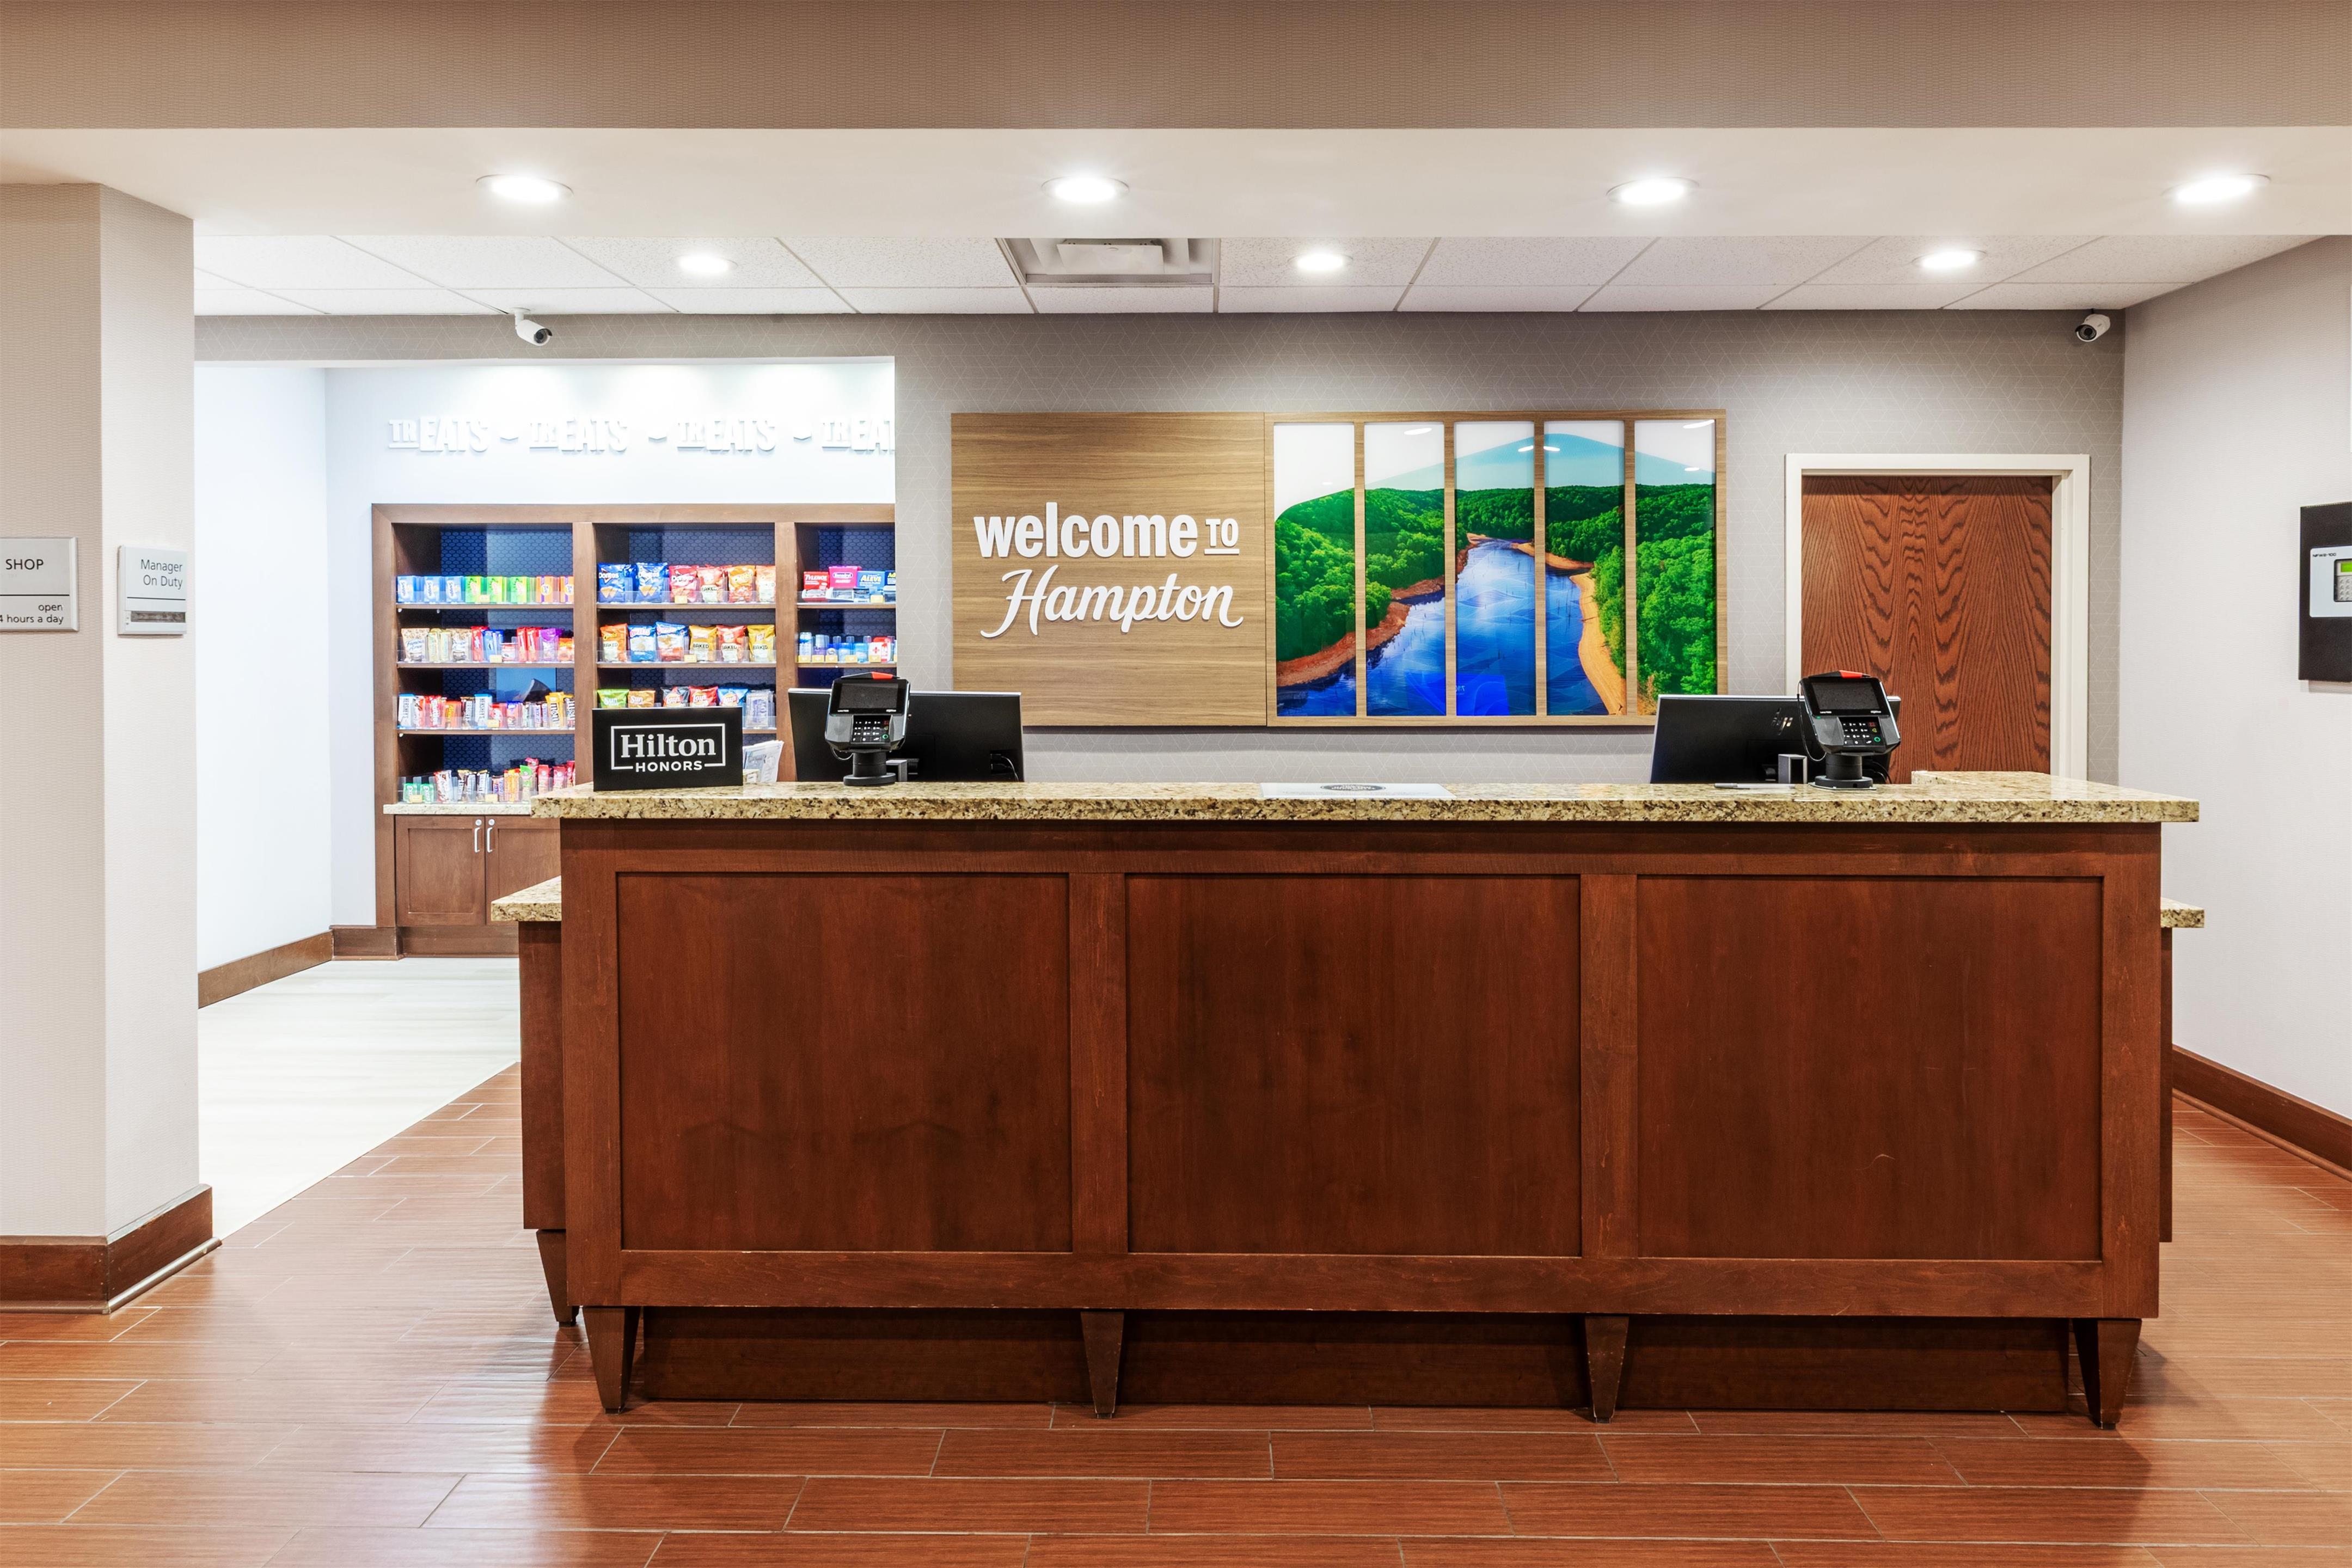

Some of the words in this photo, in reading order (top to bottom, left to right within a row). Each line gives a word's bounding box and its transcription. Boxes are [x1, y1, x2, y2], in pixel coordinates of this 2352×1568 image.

[389, 417, 488, 452] TREATS
[973, 502, 1198, 558] welcome
[1205, 518, 1240, 547] TO
[5, 559, 44, 570] SHOP
[140, 559, 183, 574] Manager
[143, 574, 157, 586] On
[161, 575, 183, 590] Duty
[38, 604, 63, 613] open
[981, 565, 1244, 638] Hampton
[7, 614, 34, 623] hours
[46, 614, 64, 625] day
[621, 733, 716, 758] Hilton
[635, 761, 703, 773] HONORS
